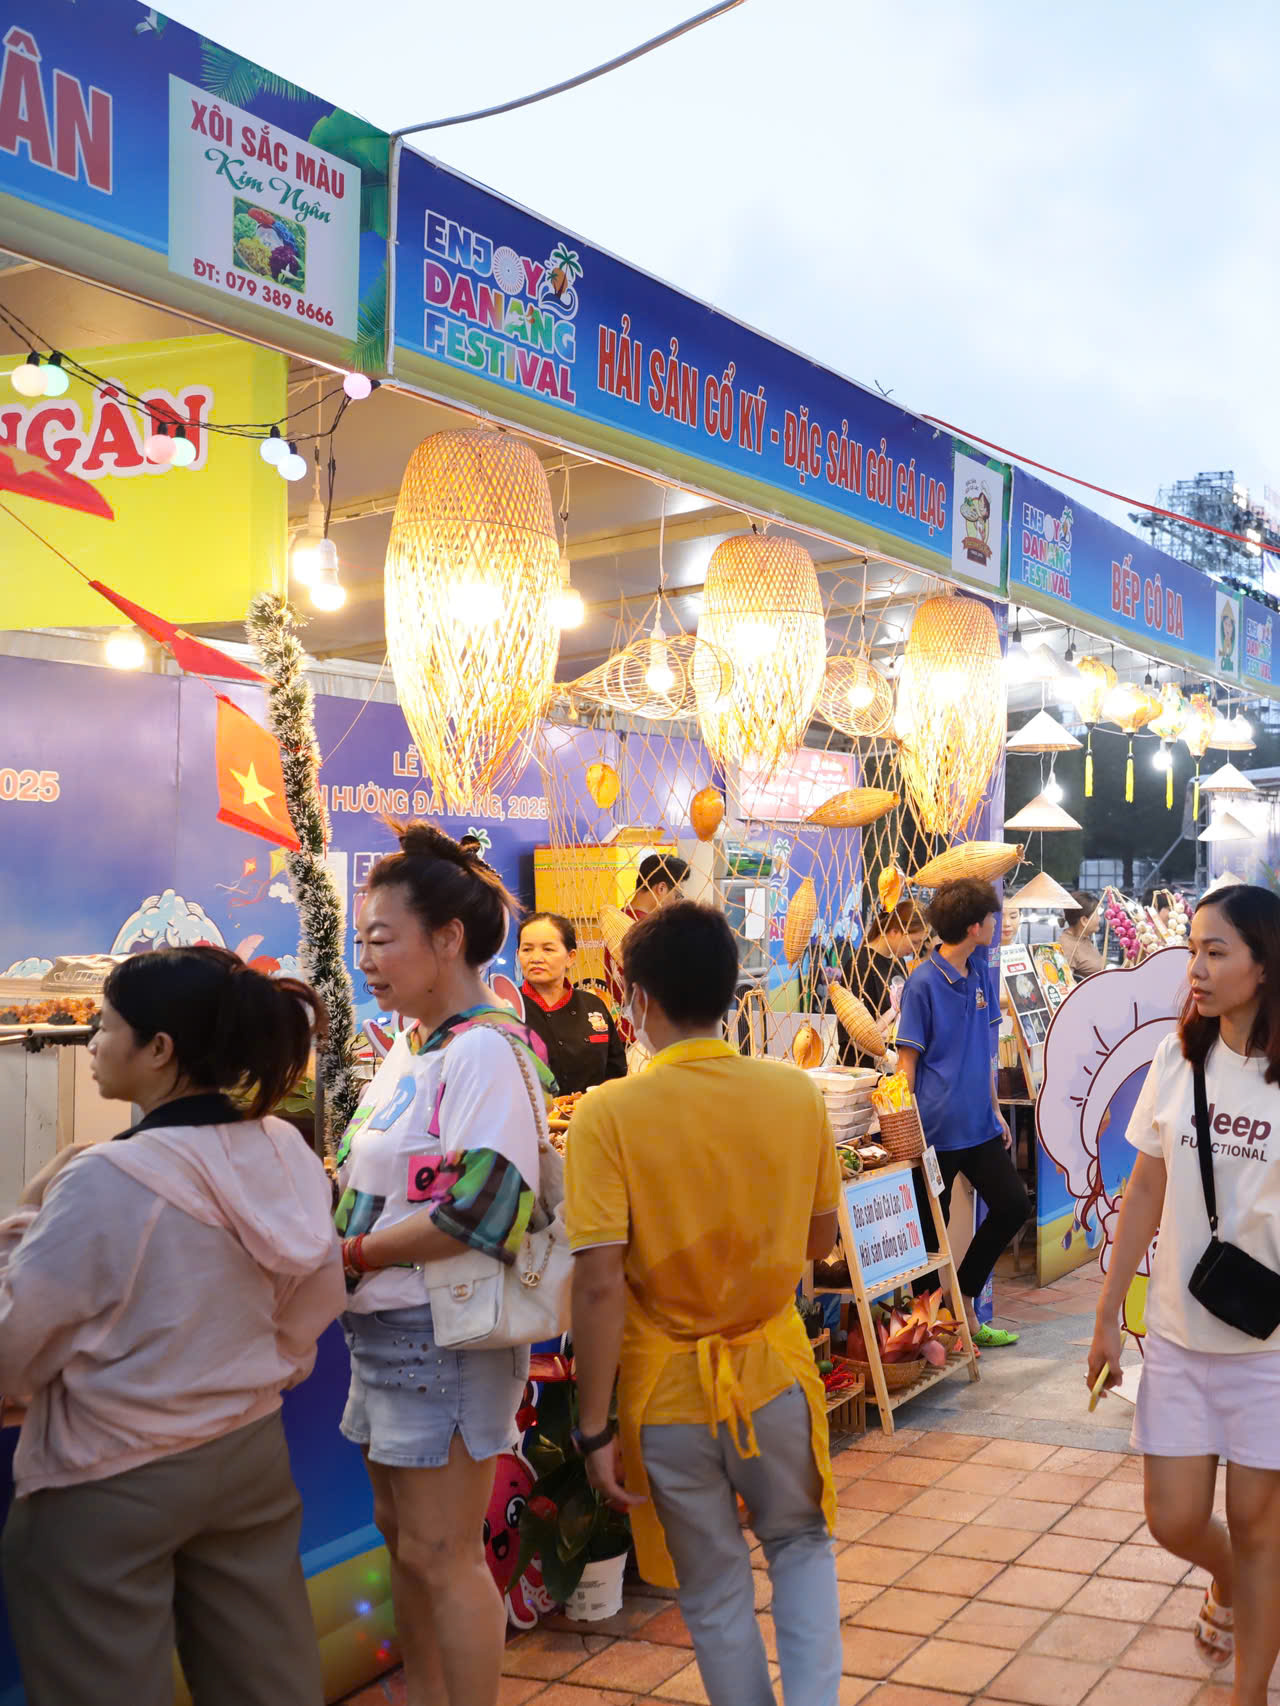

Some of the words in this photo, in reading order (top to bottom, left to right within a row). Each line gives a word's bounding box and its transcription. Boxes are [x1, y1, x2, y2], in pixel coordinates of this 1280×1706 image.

[190, 99, 233, 147] XÔI
[240, 124, 288, 173] SẮC
[295, 151, 345, 200] MÀU
[204, 149, 264, 194] Kim
[269, 176, 331, 224] Ngân
[193, 257, 220, 284] ĐT:
[226, 271, 258, 301] 079
[262, 285, 292, 311] 389
[296, 300, 334, 327] 8666
[424, 259, 577, 364] DANANG
[424, 309, 577, 406] FESTIVAL
[598, 313, 642, 406] HẢI
[648, 336, 698, 429] SẢN
[704, 361, 736, 442] CỔ
[739, 385, 767, 455] KÝ
[783, 405, 822, 486] ĐẶC
[826, 419, 863, 496] SẢN
[866, 438, 893, 509] GỎI
[896, 458, 916, 519] CÁ
[919, 473, 947, 537] LẠC
[1022, 529, 1072, 576] DANANG
[1022, 557, 1071, 600] FESTIVAL
[1112, 553, 1141, 620] BẾP
[1144, 573, 1163, 631] CÔ
[1166, 587, 1184, 640] BA
[393, 745, 419, 777] LỄ
[332, 781, 409, 815] HƯỞNG
[508, 795, 550, 820] 2025
[1181, 1135, 1267, 1162] FUCTIONAL
